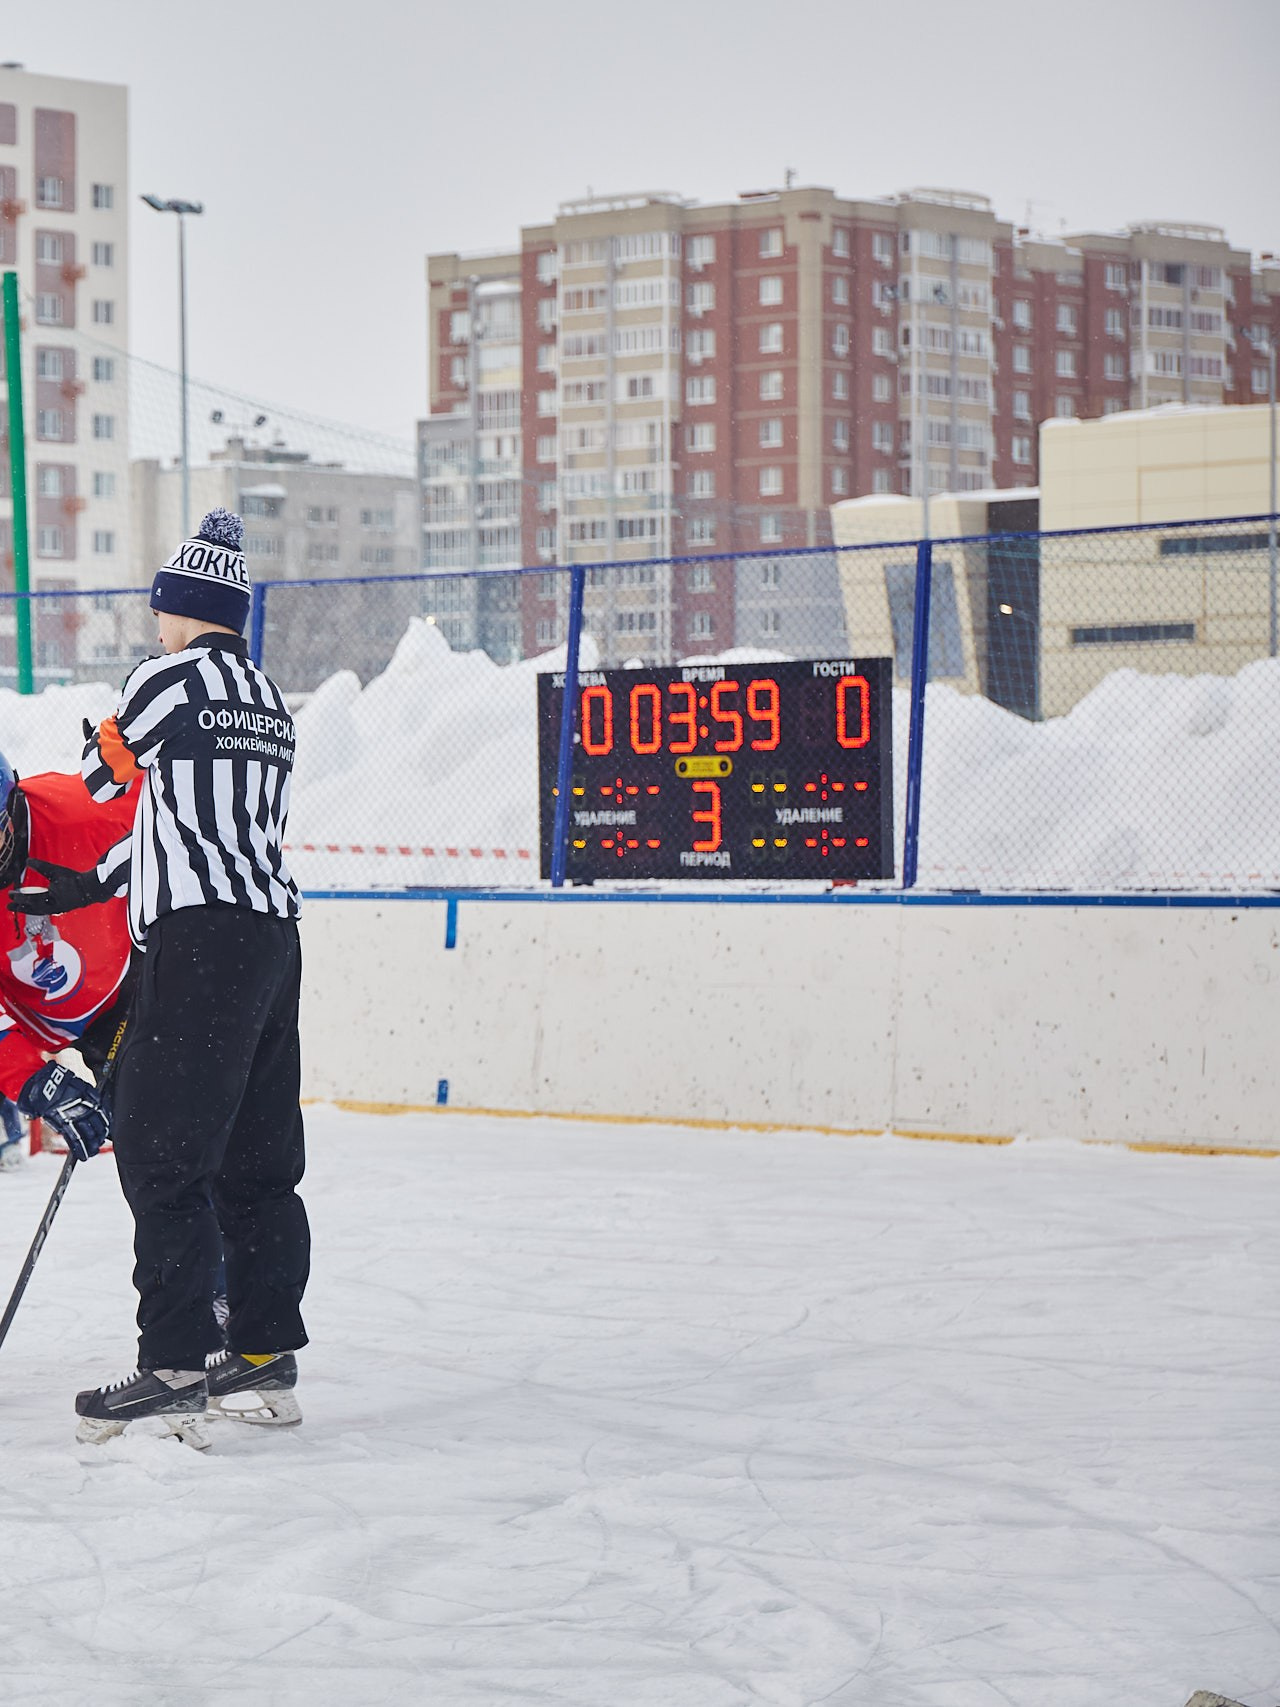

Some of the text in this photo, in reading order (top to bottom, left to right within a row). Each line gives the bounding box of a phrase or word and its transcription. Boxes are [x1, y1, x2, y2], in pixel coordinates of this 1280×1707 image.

[682, 667, 726, 682] ВРЕМЯ
[813, 661, 856, 677] ГОСТИ
[581, 685, 613, 756] 0
[629, 678, 781, 755] 03:59
[835, 675, 871, 750] 0
[215, 735, 278, 757] ХОККЕЙНАЯ
[574, 810, 637, 827] УДАЛЕНИЕ
[691, 781, 722, 852] 3
[775, 807, 844, 825] УДАЛЕНИЕ
[679, 851, 732, 869] ПЕРИОД
